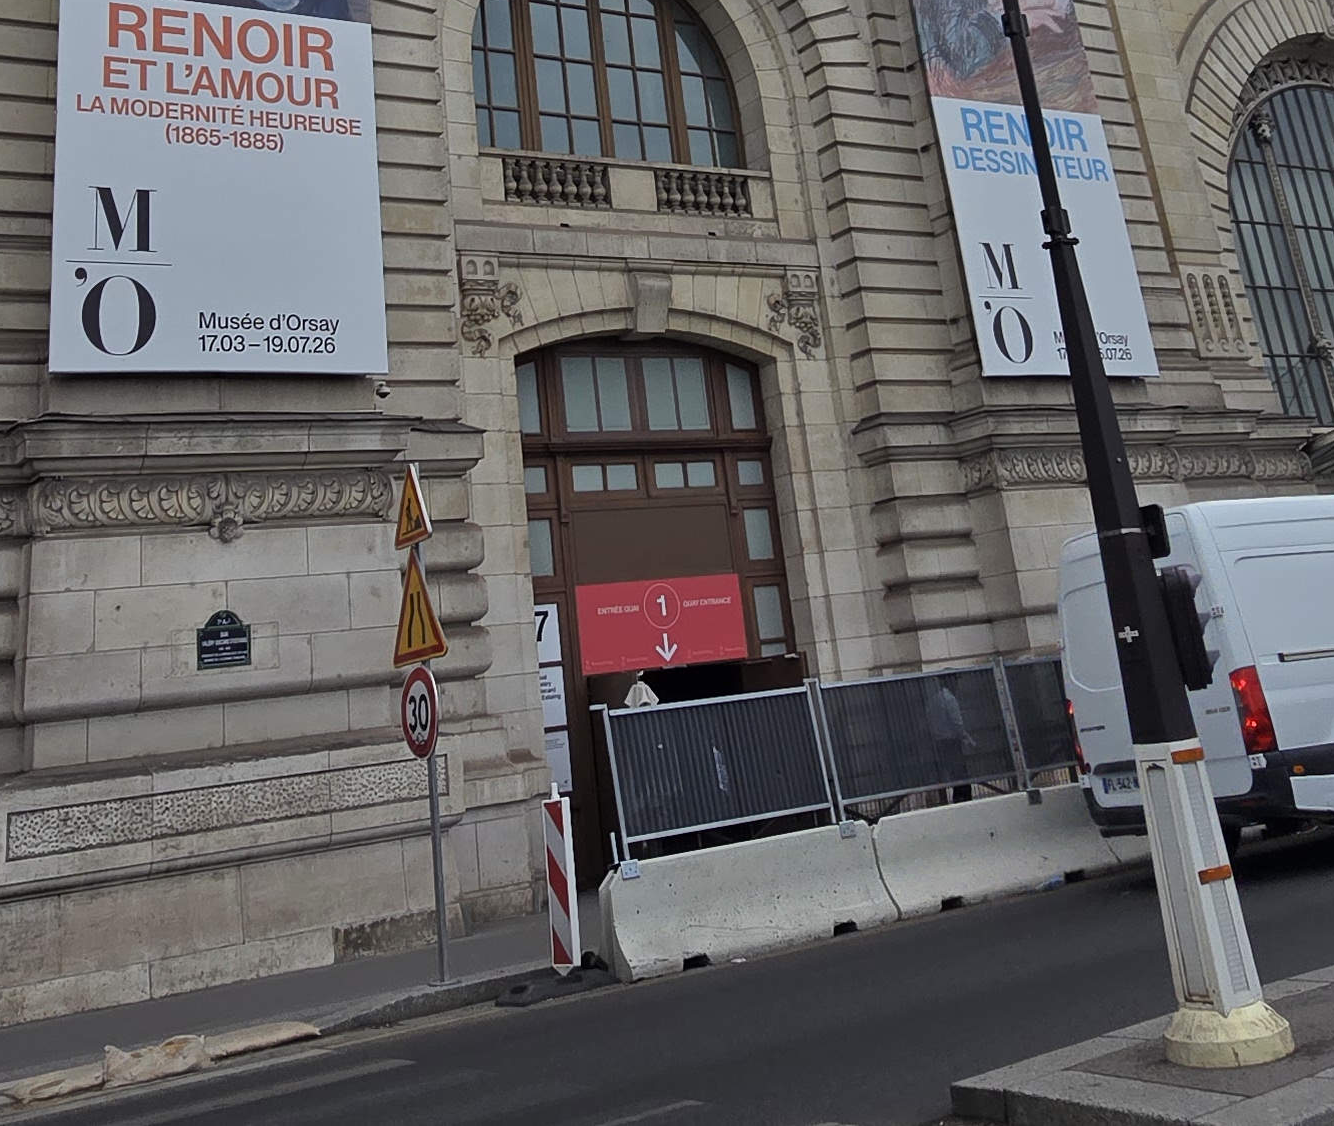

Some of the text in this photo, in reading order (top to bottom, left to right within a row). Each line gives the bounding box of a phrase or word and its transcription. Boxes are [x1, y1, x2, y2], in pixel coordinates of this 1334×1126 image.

[107, 2, 335, 72] RENOIR
[102, 56, 340, 110] ET L'AMOUR
[76, 94, 362, 136] LA MODERNITÉ HEUREUSE
[165, 123, 285, 154] (1865-1885)
[951, 145, 1110, 182] DESSINTEUR
[87, 185, 158, 253] M
[978, 242, 1023, 290] M
[198, 311, 340, 335] Musée d'Orsay
[1096, 331, 1129, 348] 'Orsay
[198, 335, 246, 353] 17.03
[264, 336, 336, 354] 19.07.26
[1098, 347, 1133, 361] 5.07.26
[656, 594, 667, 617] 1
[408, 693, 429, 734] 30
[1108, 776, 1140, 791] FL-542-N
